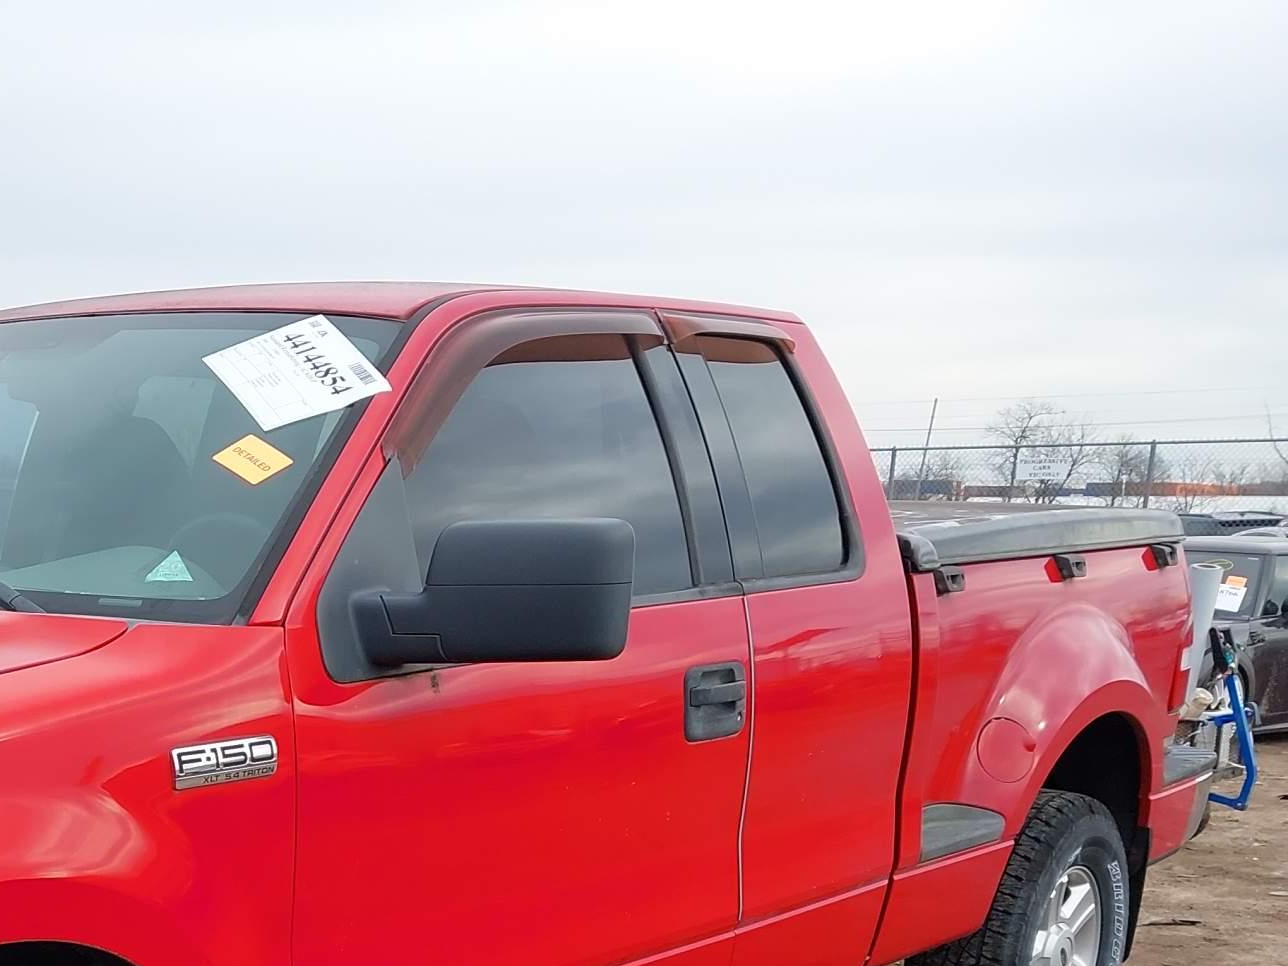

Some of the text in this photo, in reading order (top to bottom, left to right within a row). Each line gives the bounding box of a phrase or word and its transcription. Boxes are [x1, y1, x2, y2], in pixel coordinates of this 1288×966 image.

[283, 333, 353, 396] 44144854
[231, 446, 272, 473] DETAILED
[201, 774, 220, 784] XLT
[241, 766, 275, 777] TRITON
